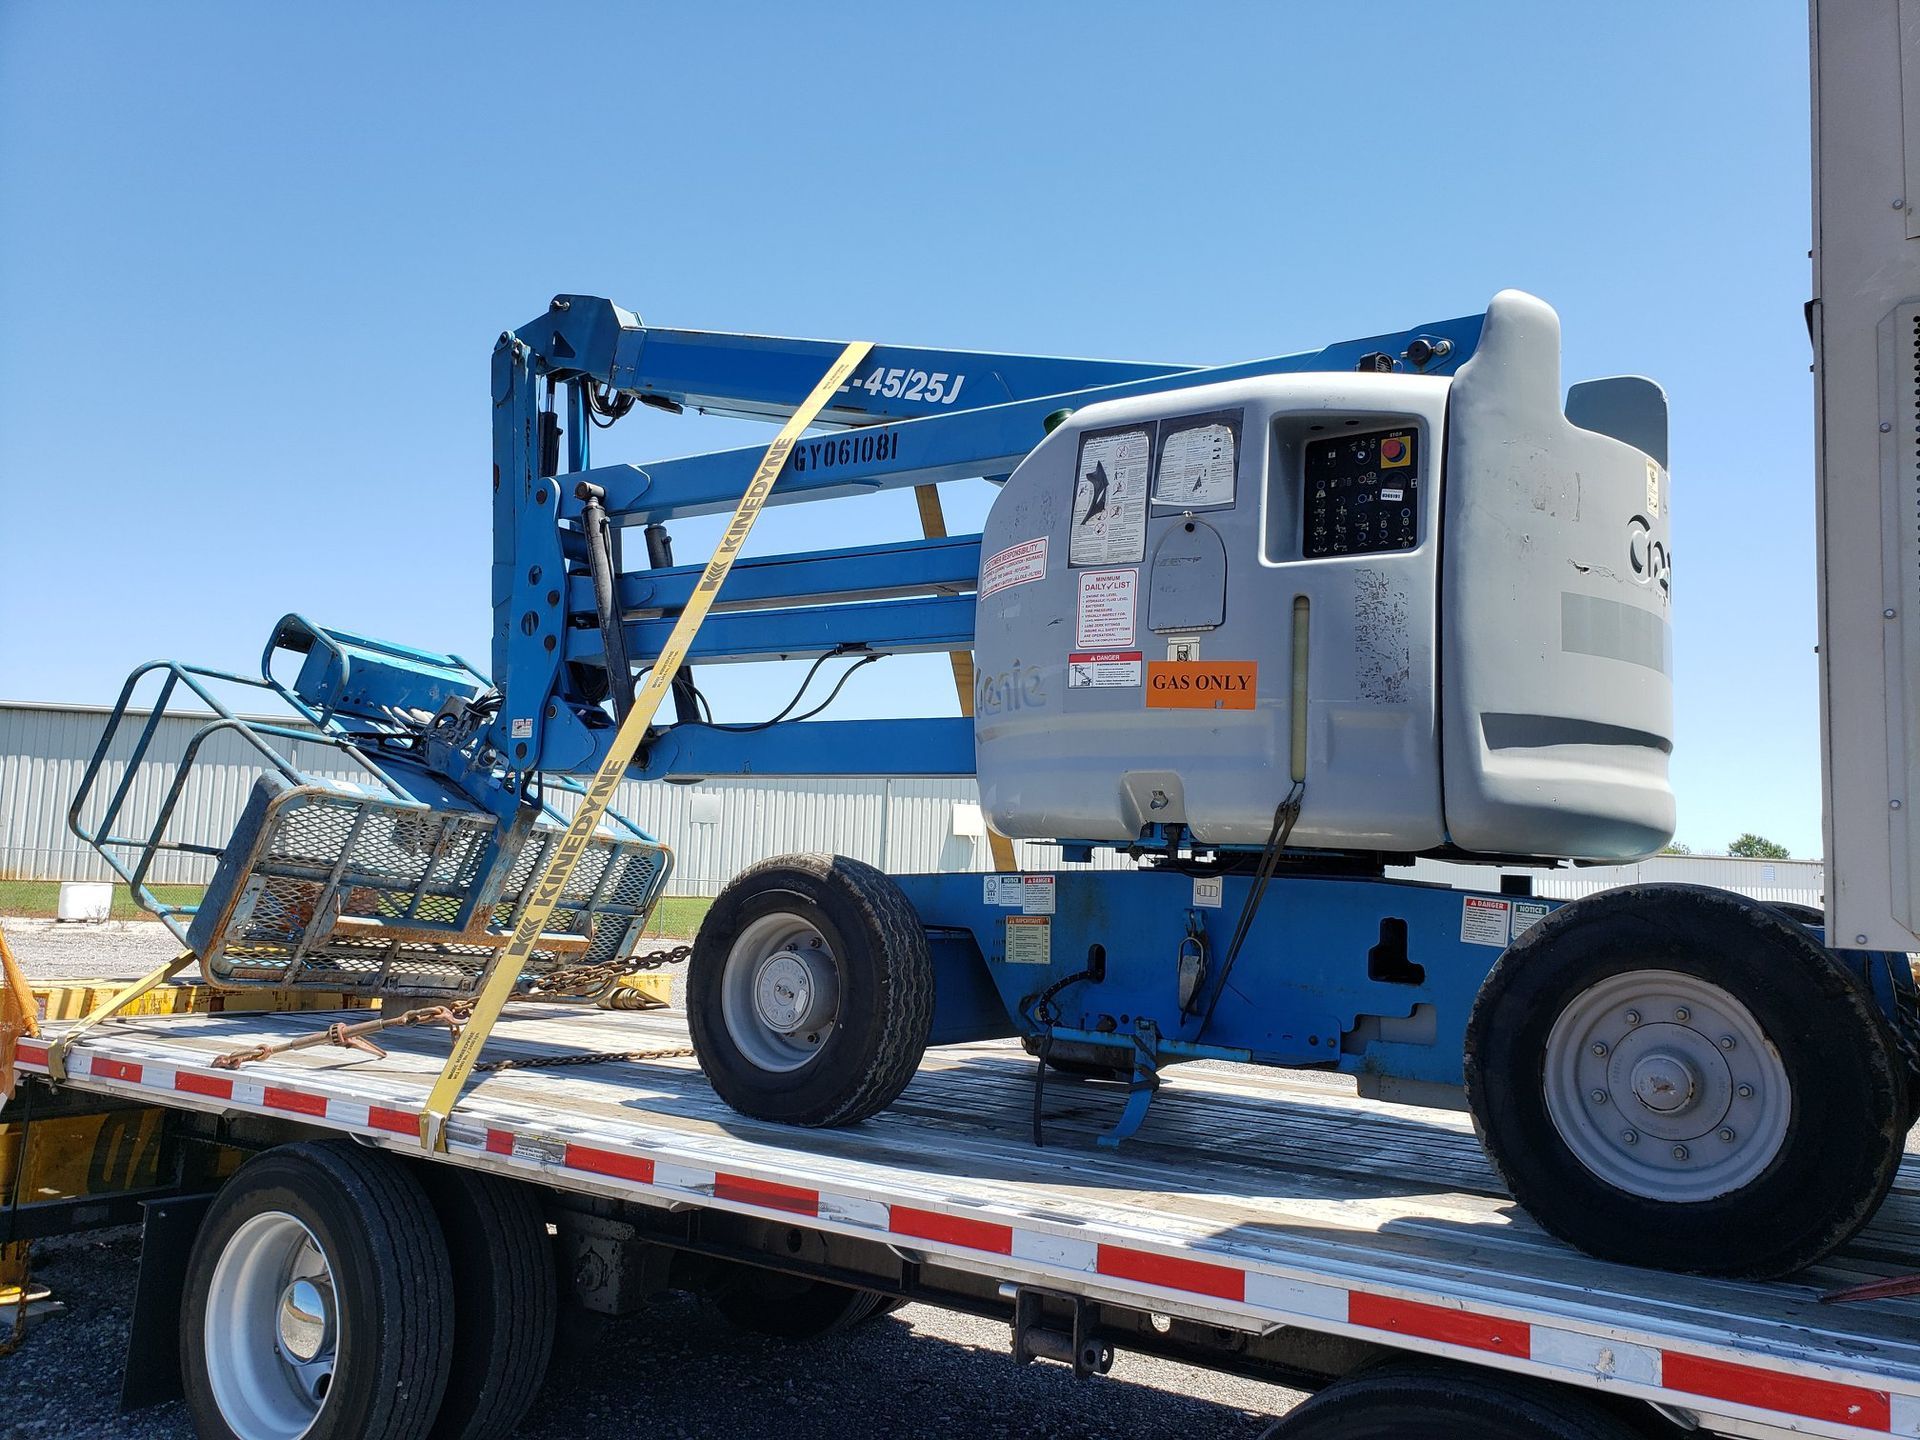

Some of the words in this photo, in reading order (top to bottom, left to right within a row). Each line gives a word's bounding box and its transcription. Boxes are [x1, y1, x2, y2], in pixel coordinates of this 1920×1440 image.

[836, 367, 965, 404] -45/25J
[794, 432, 898, 472] GY061081
[720, 437, 792, 553] KINEDYNE
[1002, 544, 1038, 560] RESPONSIBILITY
[1152, 675, 1190, 690] GAS
[1195, 675, 1251, 690] ONLY
[534, 760, 624, 906] KINEDYNE
[1478, 900, 1504, 909] DANGER
[1520, 906, 1542, 914] NOTICE
